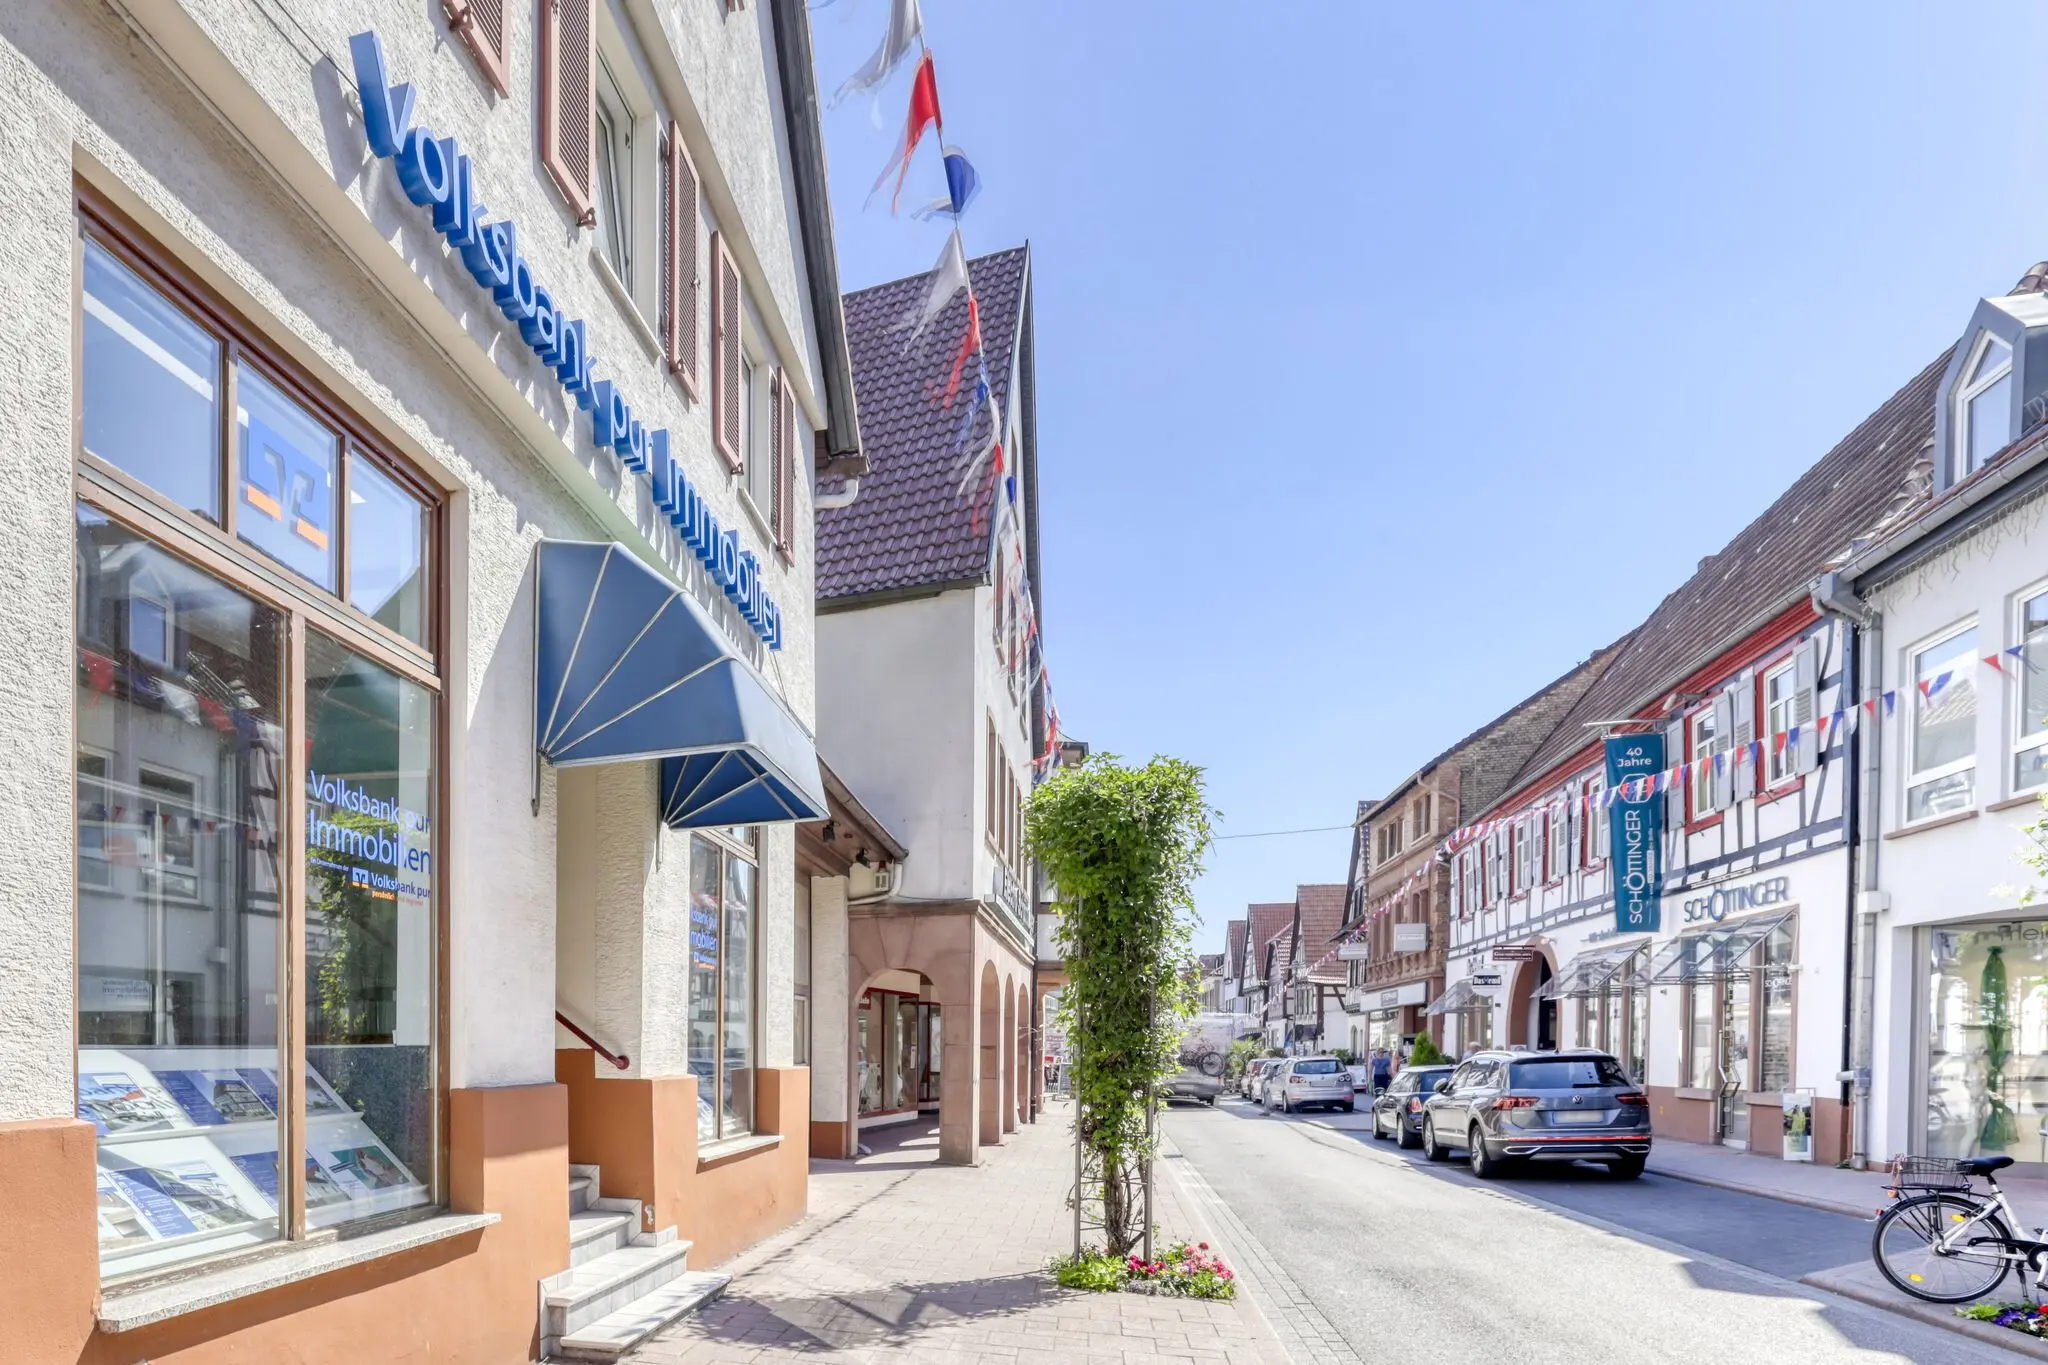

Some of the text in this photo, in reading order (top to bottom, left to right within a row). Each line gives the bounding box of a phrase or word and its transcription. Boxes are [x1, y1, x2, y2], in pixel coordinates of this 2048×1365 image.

[349, 30, 782, 651] Volksbank pur Immobilien
[1617, 758, 1652, 768] Jahre
[1626, 747, 1642, 757] 40
[310, 769, 400, 824] Volksbank
[310, 808, 431, 875] Immobilien
[1622, 810, 1646, 924] SCHÖTTINGER
[371, 872, 416, 895] Volksbank
